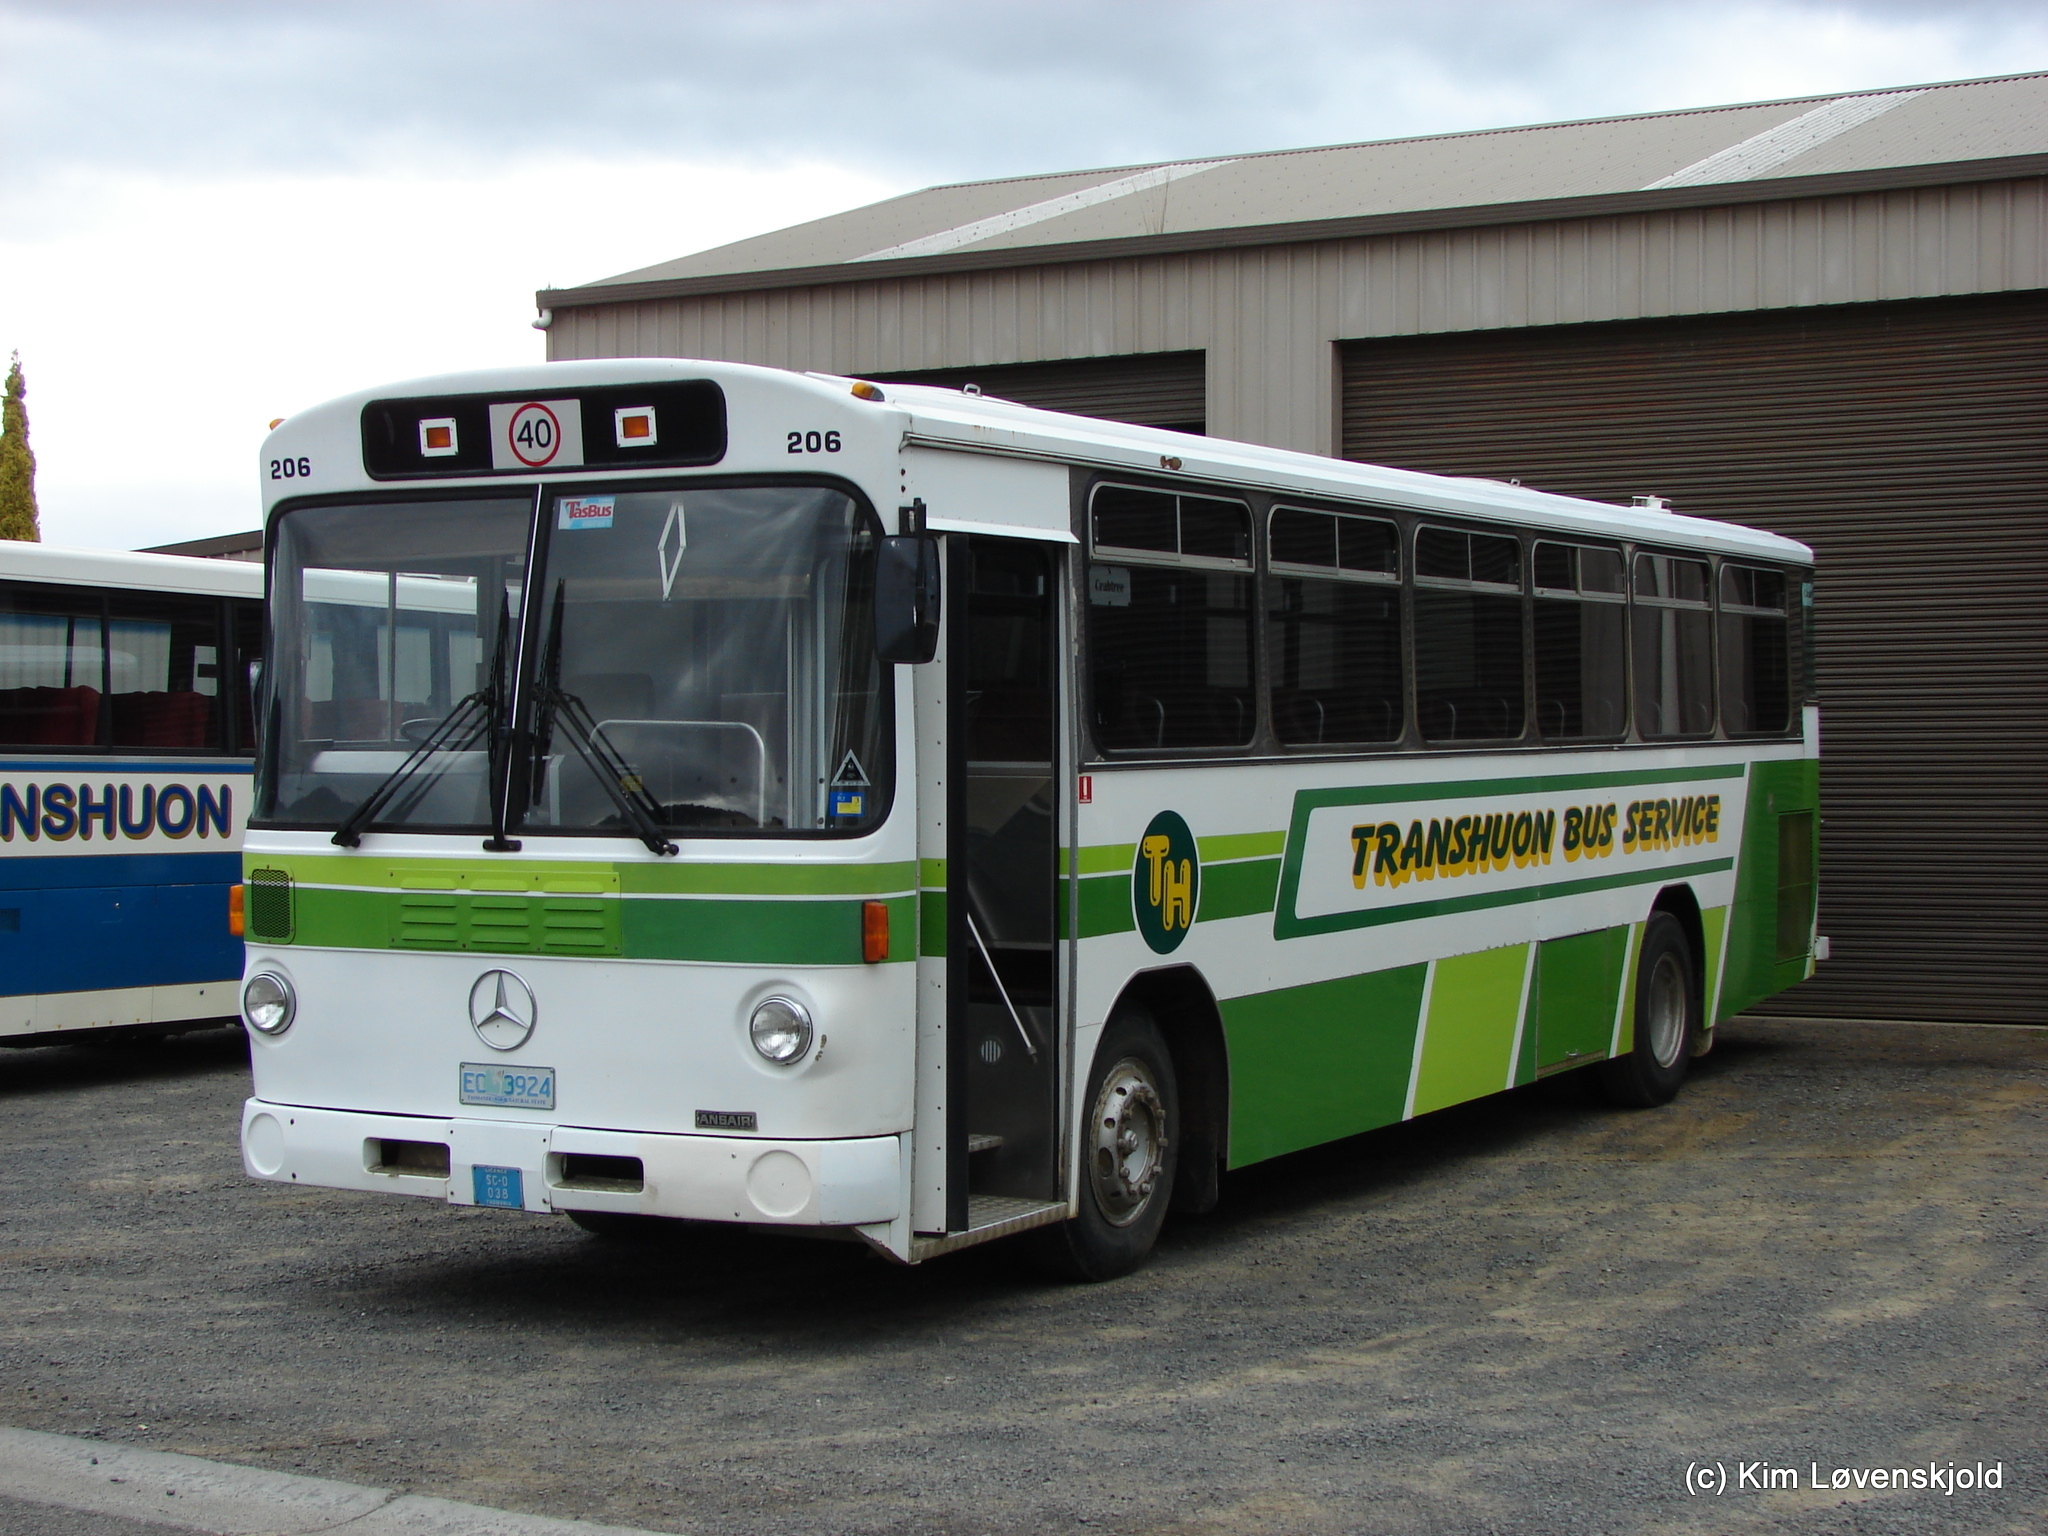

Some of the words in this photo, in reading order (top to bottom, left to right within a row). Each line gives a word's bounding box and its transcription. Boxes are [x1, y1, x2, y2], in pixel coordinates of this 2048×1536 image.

[517, 418, 552, 449] 40
[787, 431, 842, 454] 206
[270, 456, 311, 480] 206
[565, 501, 612, 519] TasBus
[0, 783, 233, 842] NSHUON
[1351, 808, 1556, 889] TRANSHUON
[1563, 803, 1618, 863] BUS
[1622, 794, 1720, 853] SERVICE
[503, 1074, 551, 1098] 3924
[700, 1113, 751, 1127] ANSAIR
